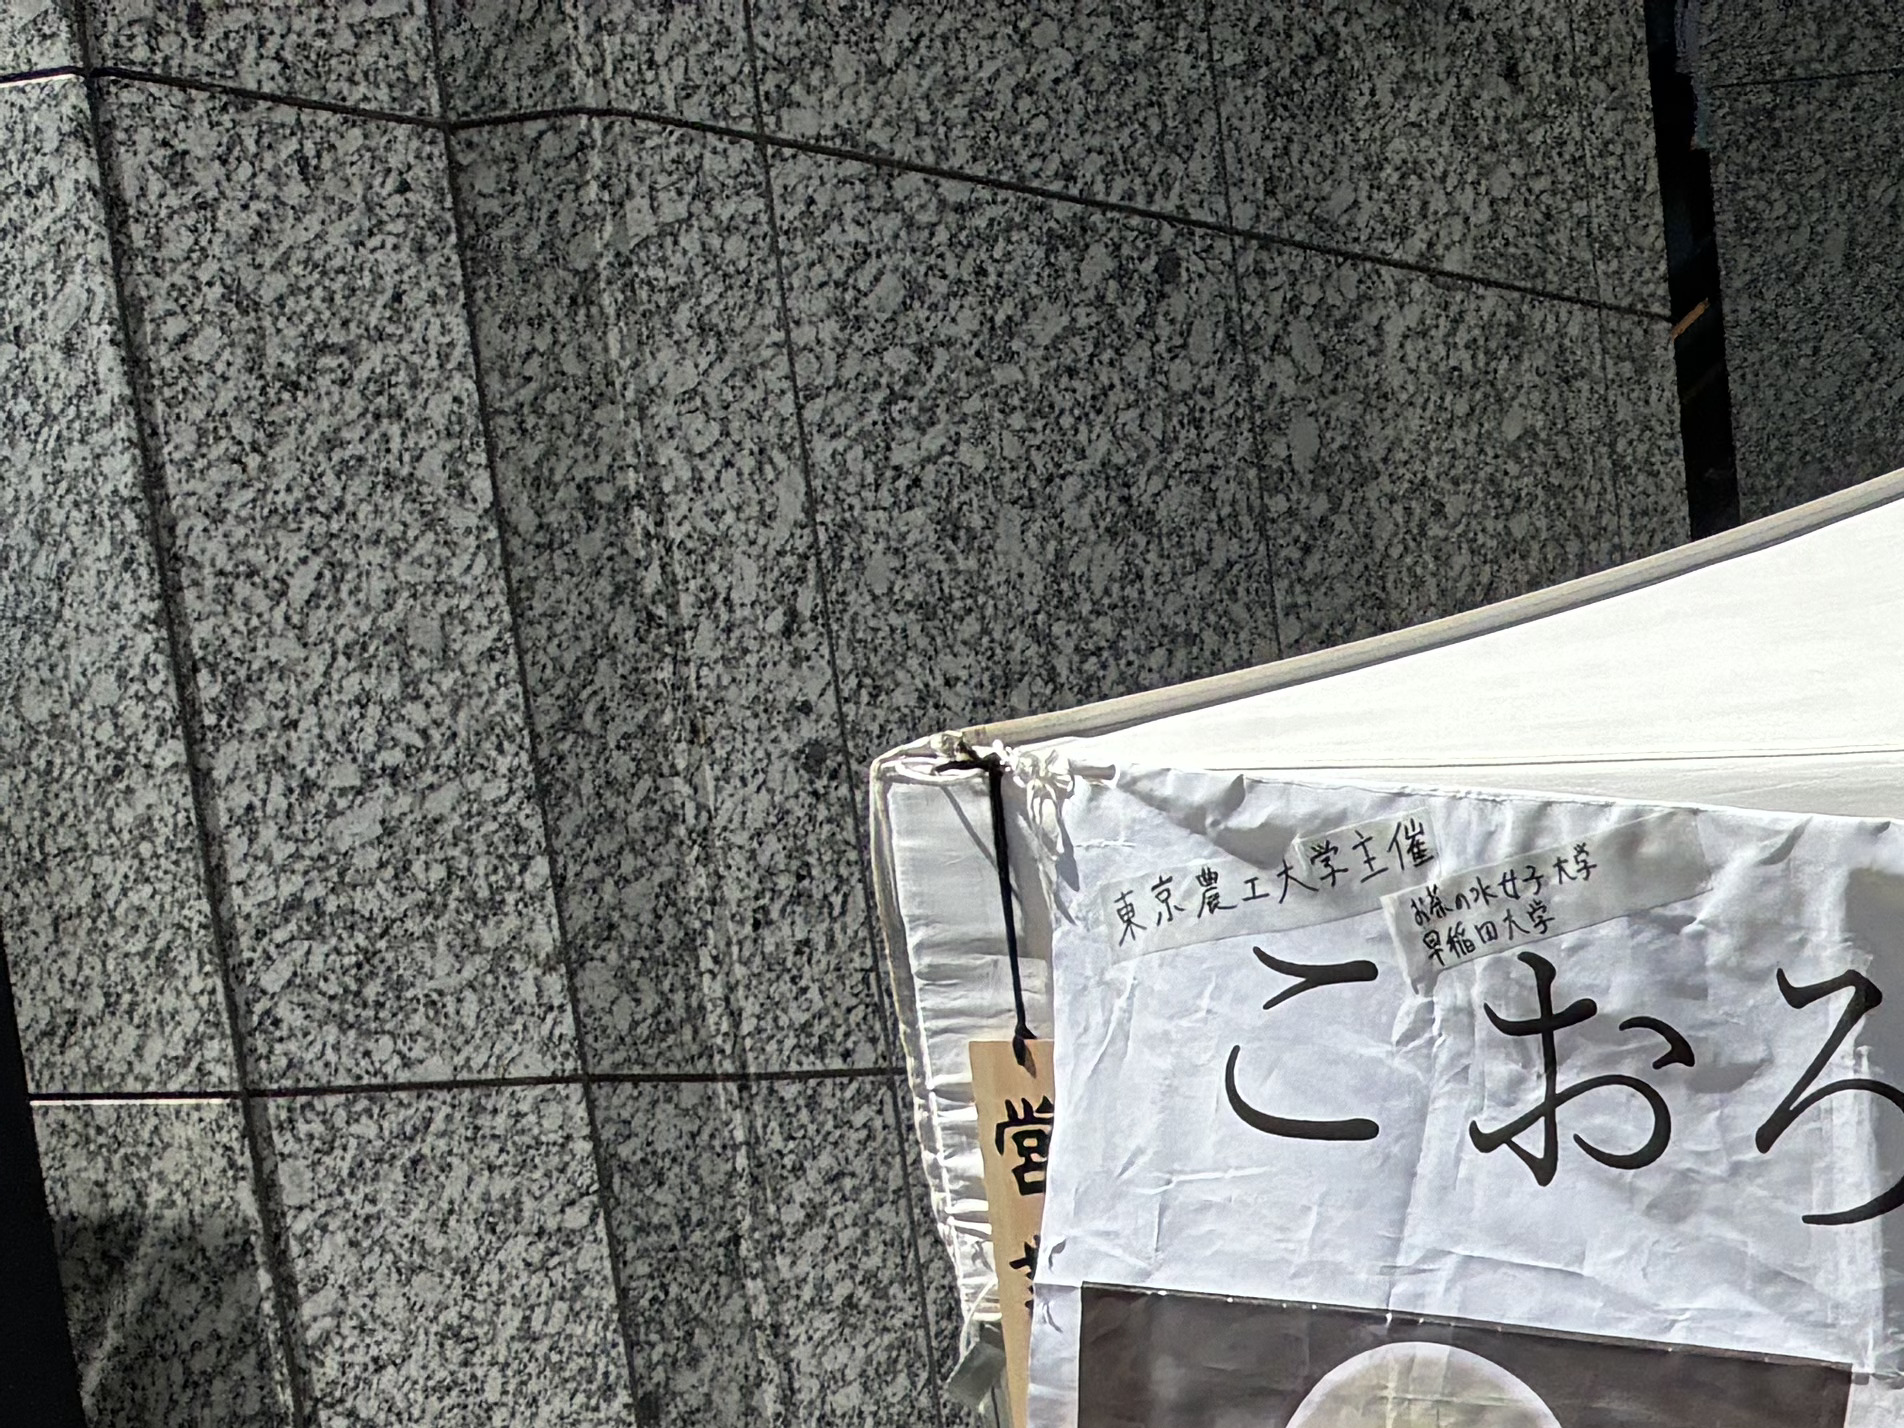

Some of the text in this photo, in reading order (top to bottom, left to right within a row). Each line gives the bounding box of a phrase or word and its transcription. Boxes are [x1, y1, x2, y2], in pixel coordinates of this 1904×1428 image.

[1113, 818, 1437, 947] 東京農工大学主催
[1410, 842, 1598, 925] お茶の水女子大学
[1422, 901, 1556, 967] 早稲田大学
